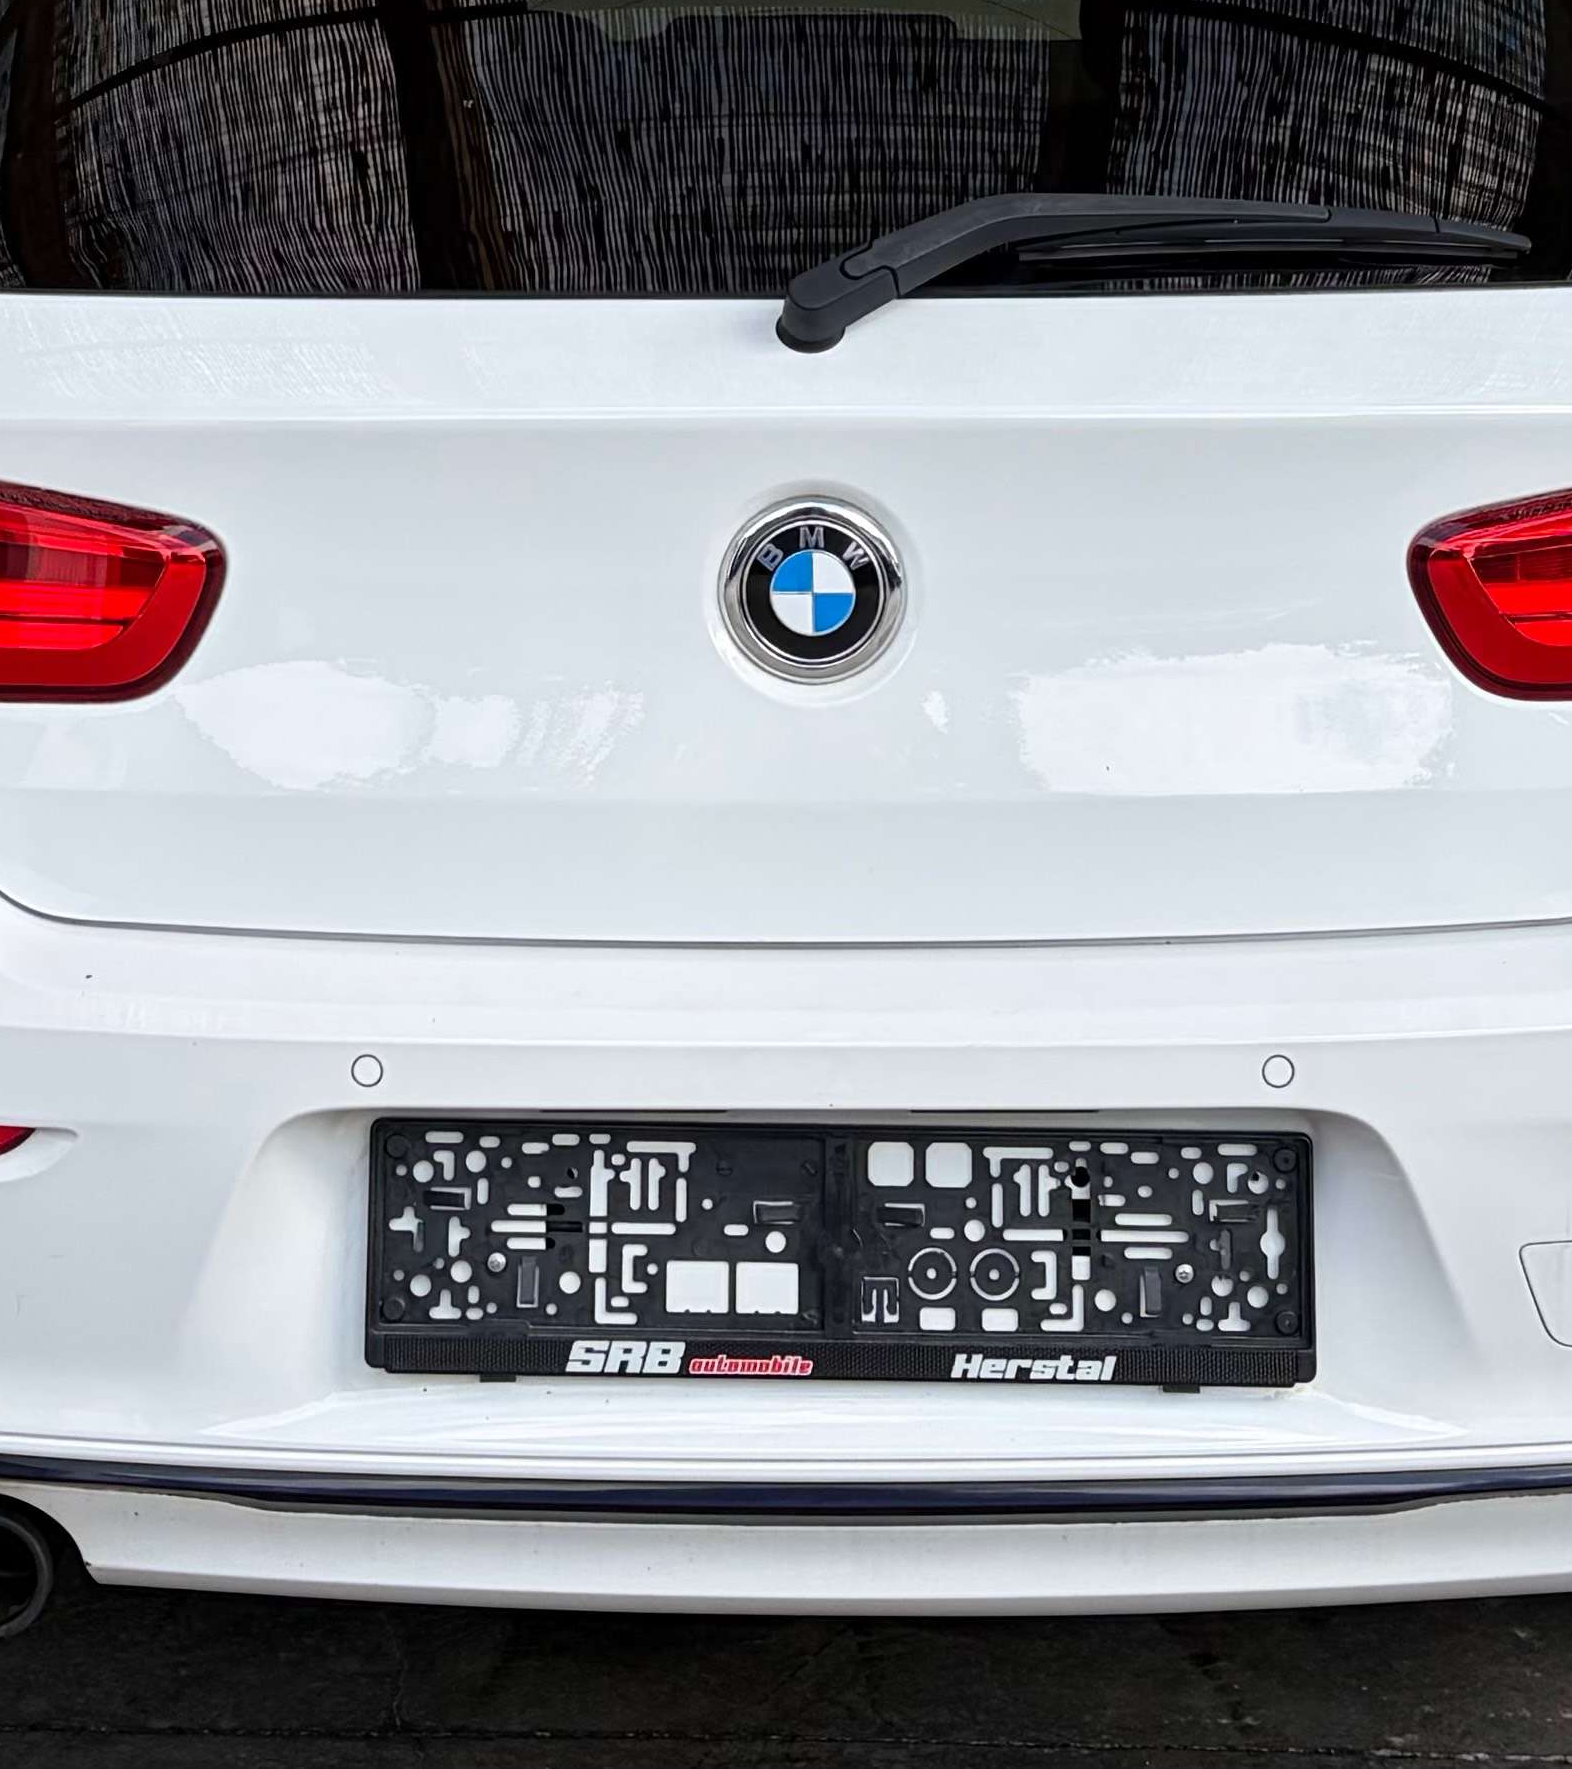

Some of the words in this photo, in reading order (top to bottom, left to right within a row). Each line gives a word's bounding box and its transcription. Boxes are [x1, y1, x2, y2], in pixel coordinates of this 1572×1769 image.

[756, 526, 870, 572] BMW
[565, 1340, 687, 1374] SRB
[688, 1355, 814, 1376] automobile
[950, 1353, 1118, 1381] Herstal
